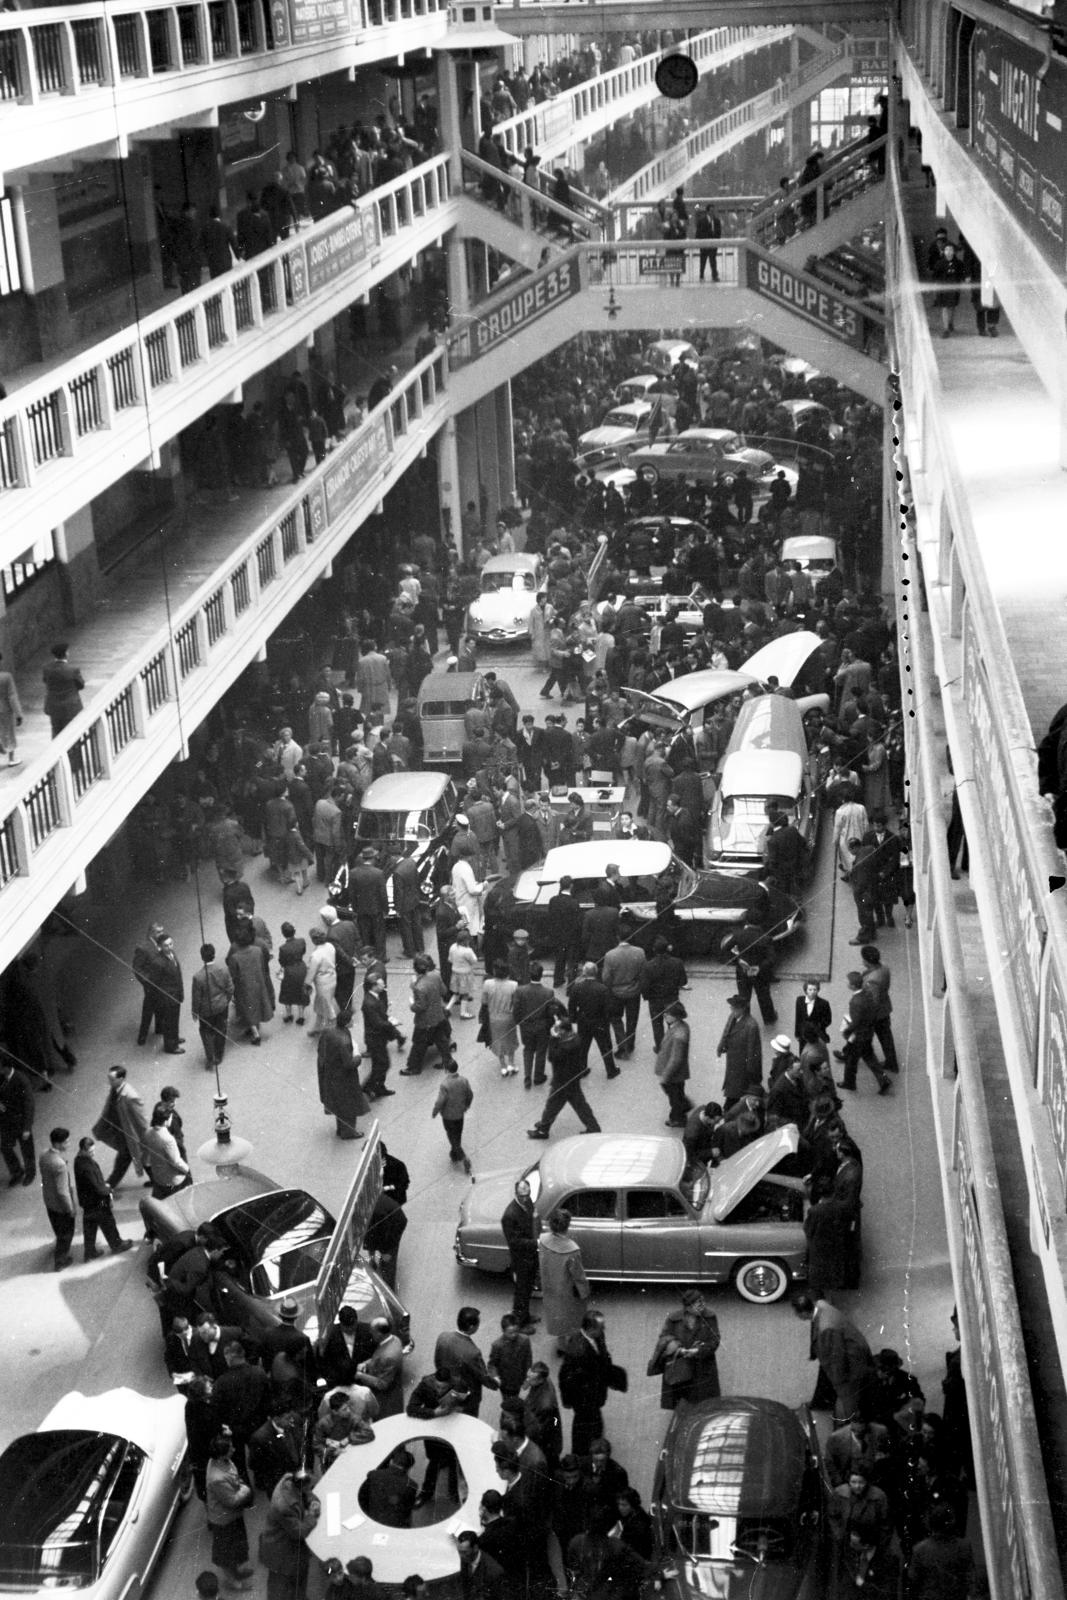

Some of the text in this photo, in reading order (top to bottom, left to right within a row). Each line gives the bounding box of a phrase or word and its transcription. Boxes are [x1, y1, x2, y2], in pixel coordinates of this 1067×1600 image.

[477, 263, 571, 347] GROUPE 33
[758, 259, 856, 335] GROUPE 33
